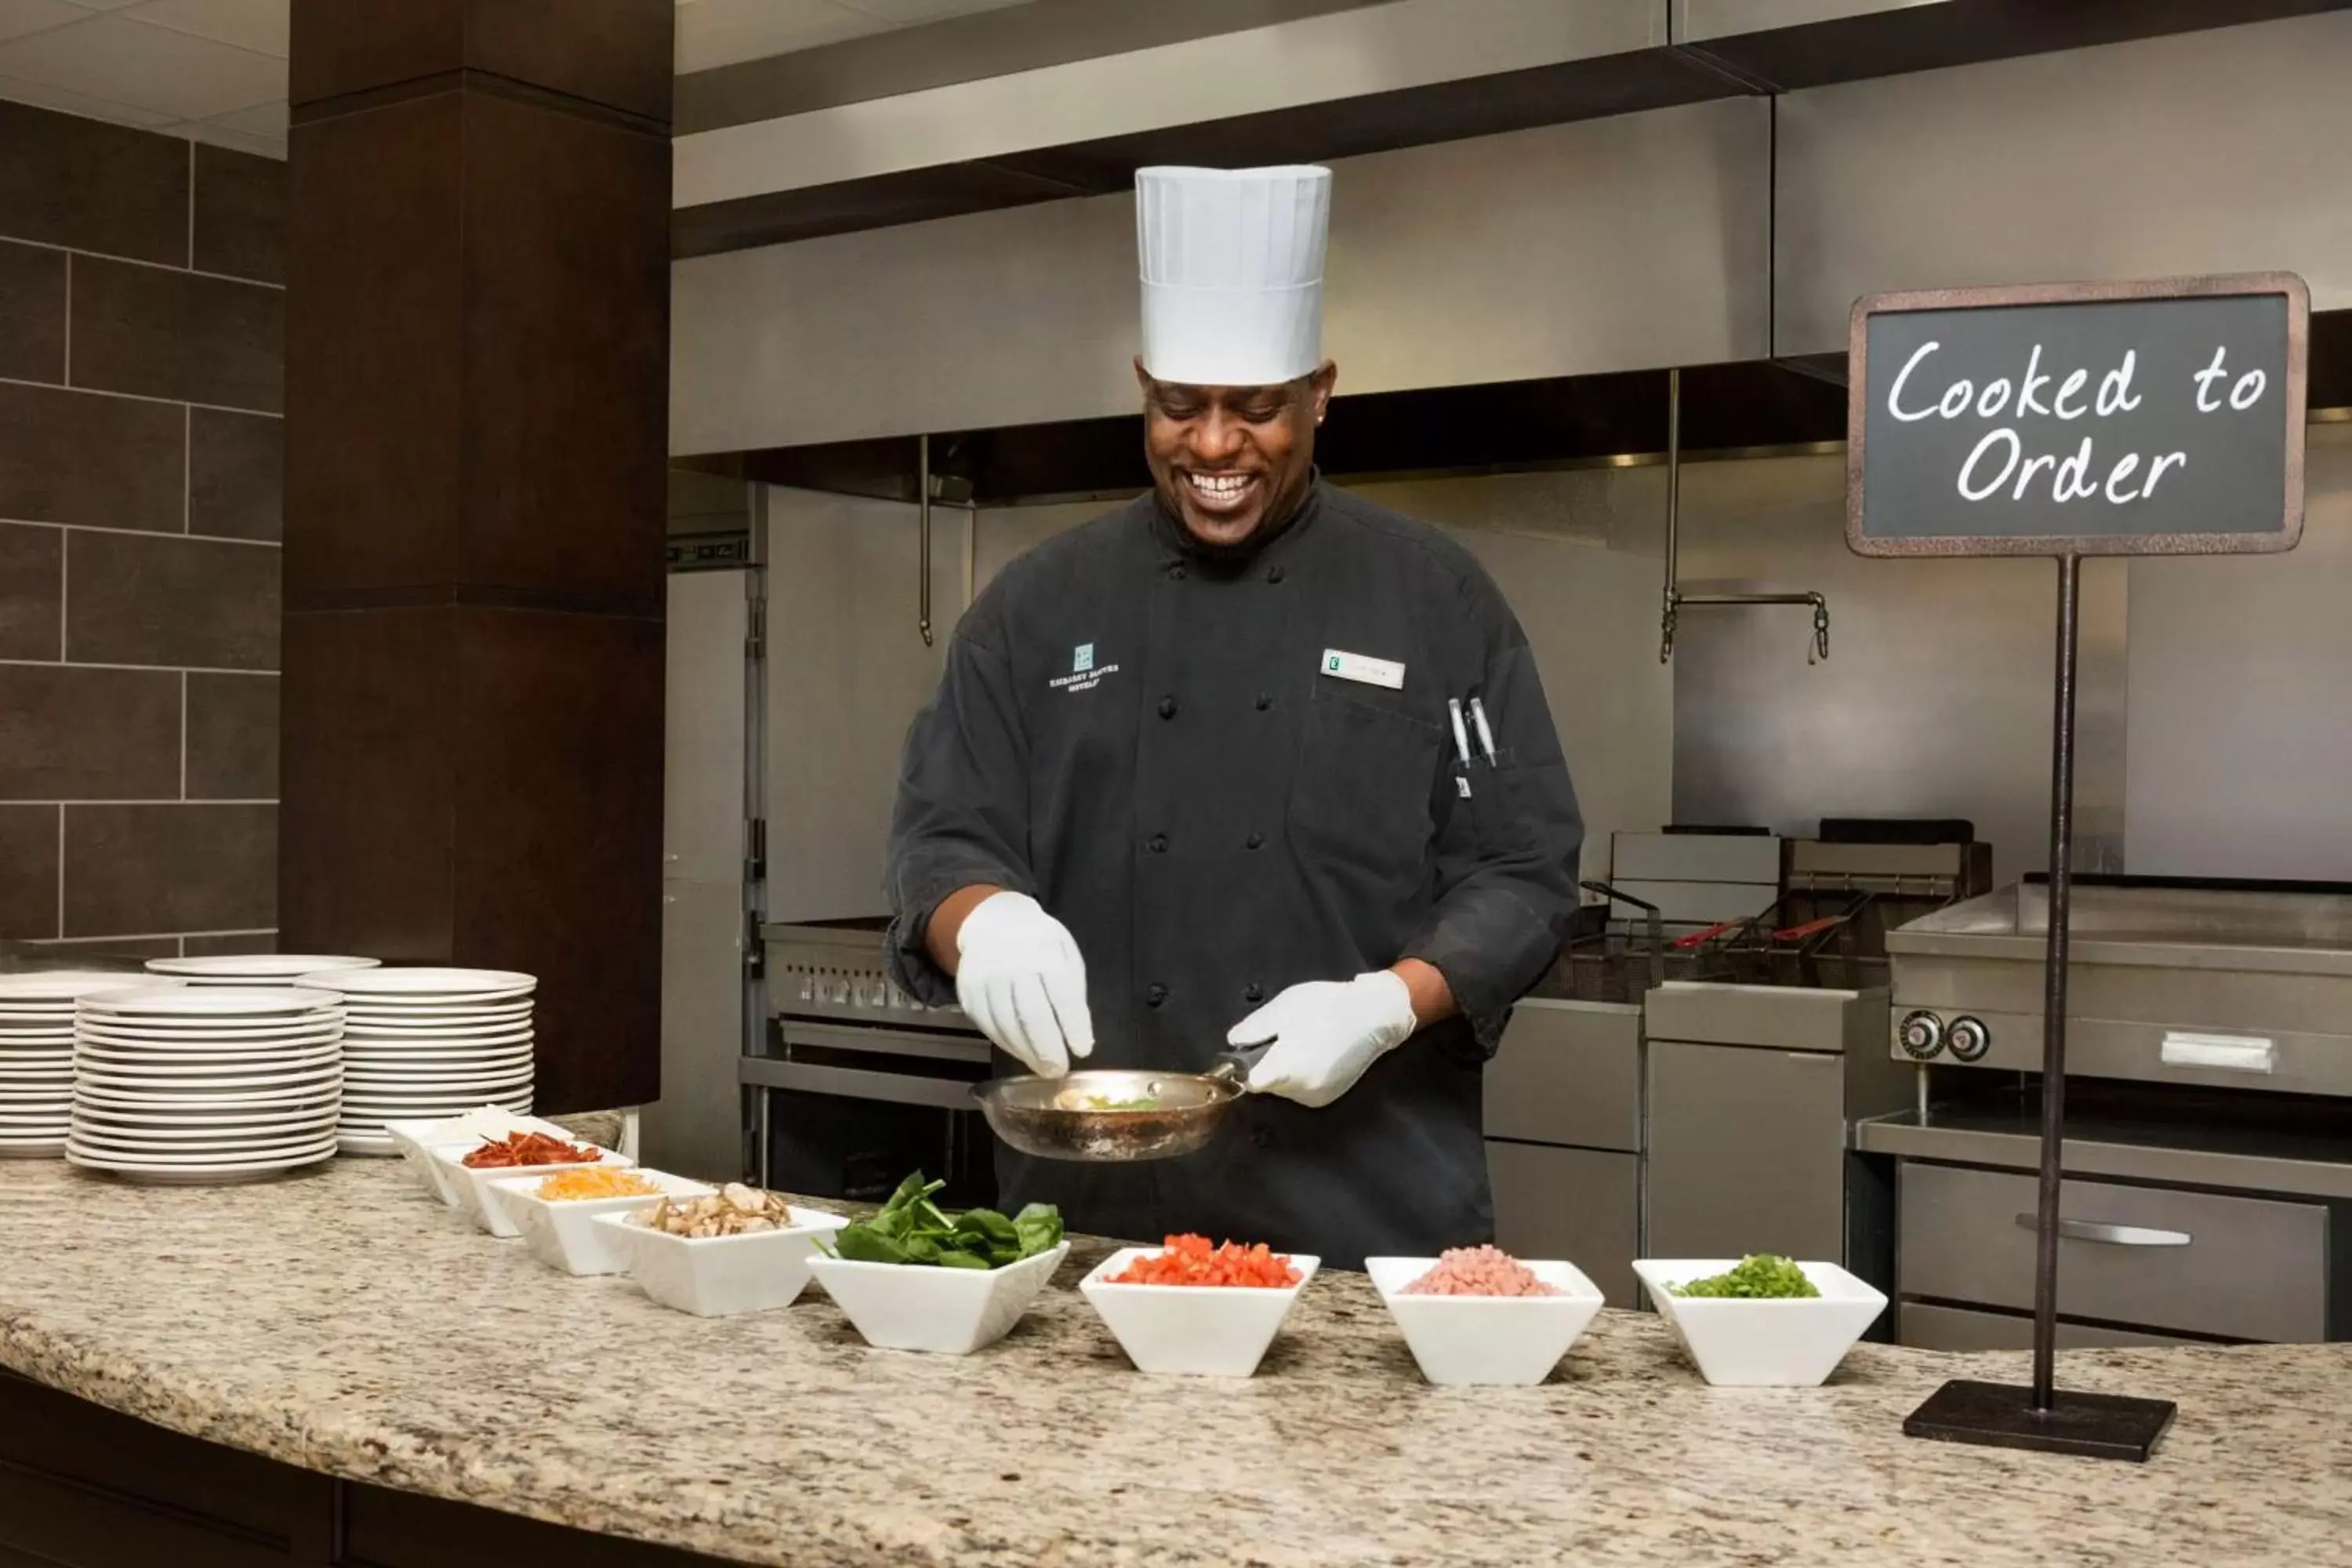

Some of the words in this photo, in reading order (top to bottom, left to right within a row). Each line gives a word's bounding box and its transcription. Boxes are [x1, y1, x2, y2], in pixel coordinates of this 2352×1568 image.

[1887, 341, 2142, 421] Cooked
[2193, 346, 2267, 413] to
[1957, 427, 2187, 504] Order
